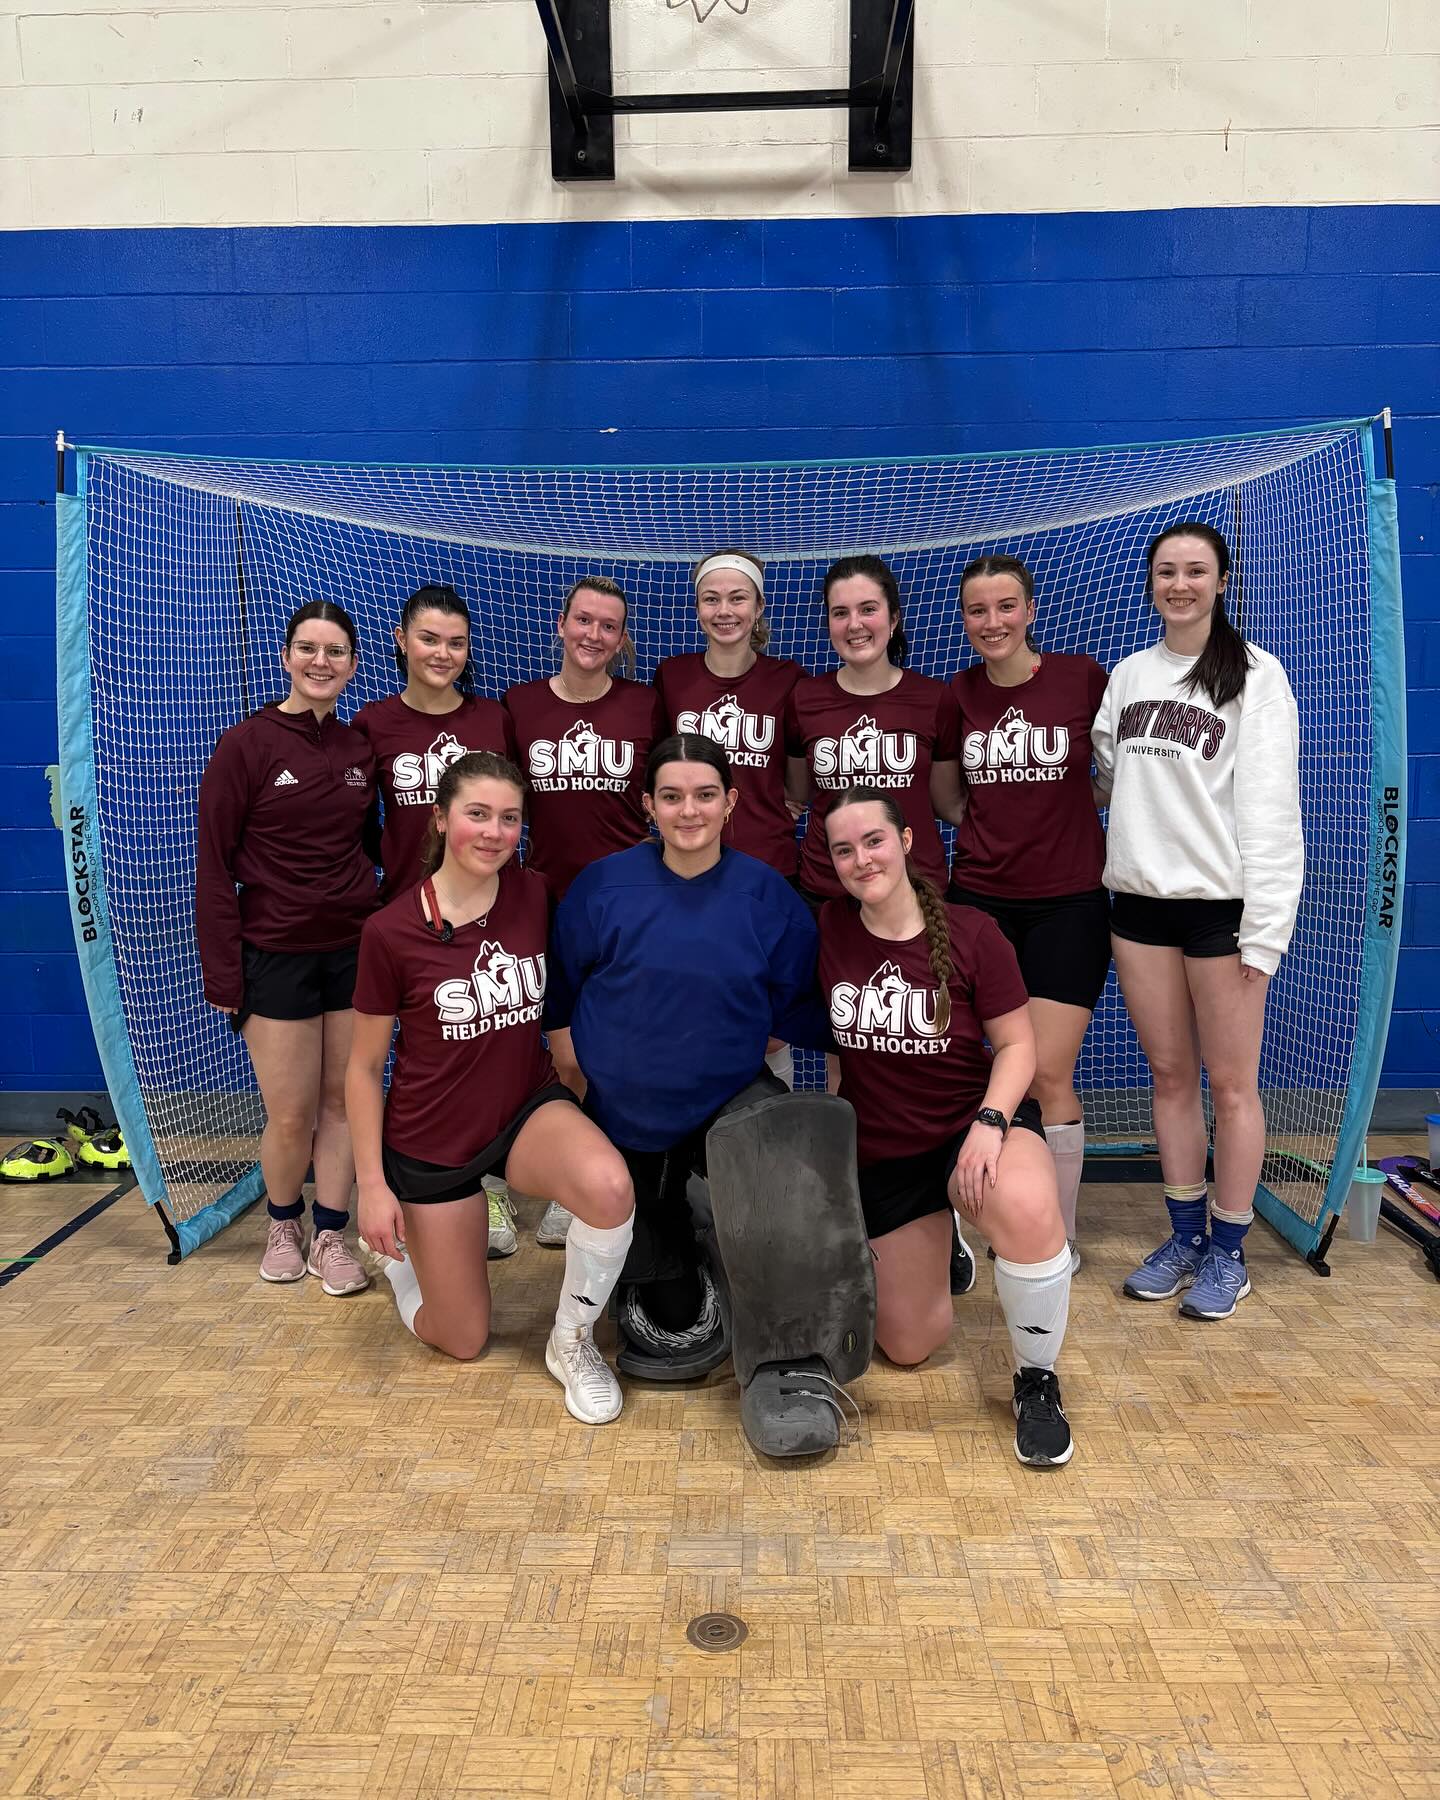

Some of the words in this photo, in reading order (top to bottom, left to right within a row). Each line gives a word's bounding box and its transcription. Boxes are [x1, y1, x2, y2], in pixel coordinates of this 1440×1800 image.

[677, 711, 776, 752] SMU
[1150, 700, 1226, 761] MARY'S
[528, 739, 635, 778] SMU
[725, 751, 770, 768] OCKEY
[813, 733, 917, 776] SMU
[962, 726, 1070, 770] SMU
[1125, 745, 1181, 760] UNIVERSITY
[531, 777, 568, 792] FIELD
[571, 777, 631, 793] HOCKEY
[815, 776, 849, 790] FIELD
[853, 774, 915, 789] HOCKEY
[1000, 766, 1069, 783] HOCKEY
[395, 790, 437, 806] FIELD
[85, 833, 94, 850] THE
[89, 852, 97, 866] ON
[1378, 787, 1399, 929] BLOCKSTAR
[70, 804, 98, 943] BLOCKSTAR
[91, 867, 99, 893] GOAL
[433, 952, 547, 1024] SMU
[829, 981, 952, 1038] SMU
[441, 1018, 491, 1041] FIELD
[871, 1037, 952, 1055] HOCKEY
